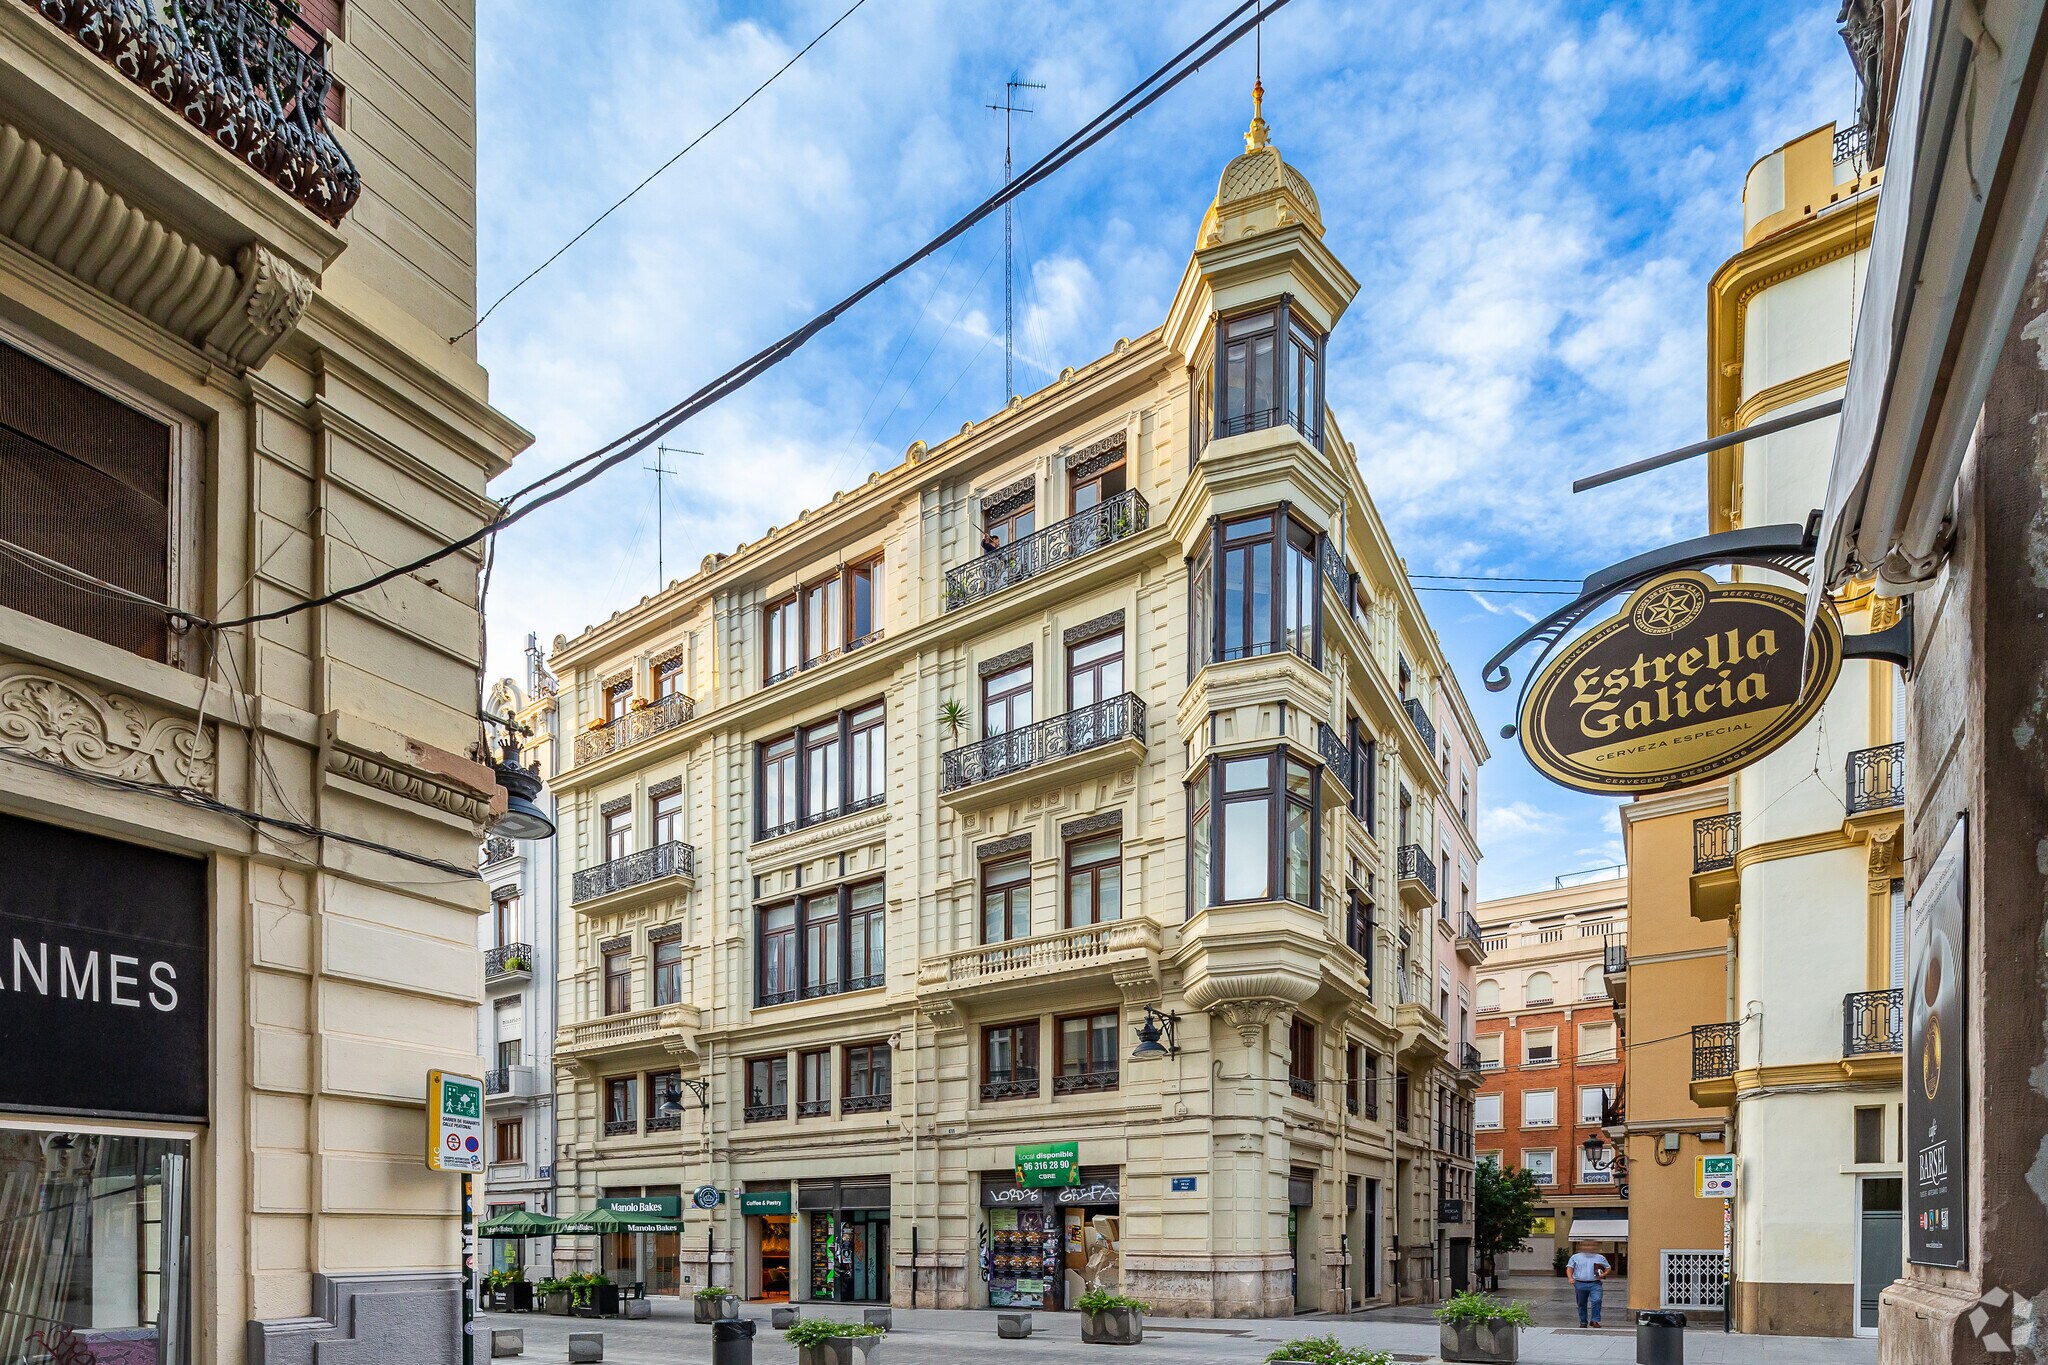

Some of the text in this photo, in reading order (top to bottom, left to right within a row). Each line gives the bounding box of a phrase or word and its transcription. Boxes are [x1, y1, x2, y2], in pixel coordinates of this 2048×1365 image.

[1569, 628, 1779, 707] Estrella
[1580, 669, 1769, 739] Galicia
[1595, 722, 1753, 762] CERVEZA ESPECIAL
[1605, 773, 1678, 785] CERVECEROS
[1681, 762, 1719, 778] DESDE
[0, 938, 178, 1012] NMES
[433, 1146, 441, 1166] VLC
[1018, 1151, 1074, 1161] Local disponible
[1023, 1159, 1069, 1171] 96 316 28 90
[1919, 1145, 1948, 1186] BARSEL
[610, 1202, 662, 1212] Manolo Bakes
[627, 1224, 656, 1232] Manolo
